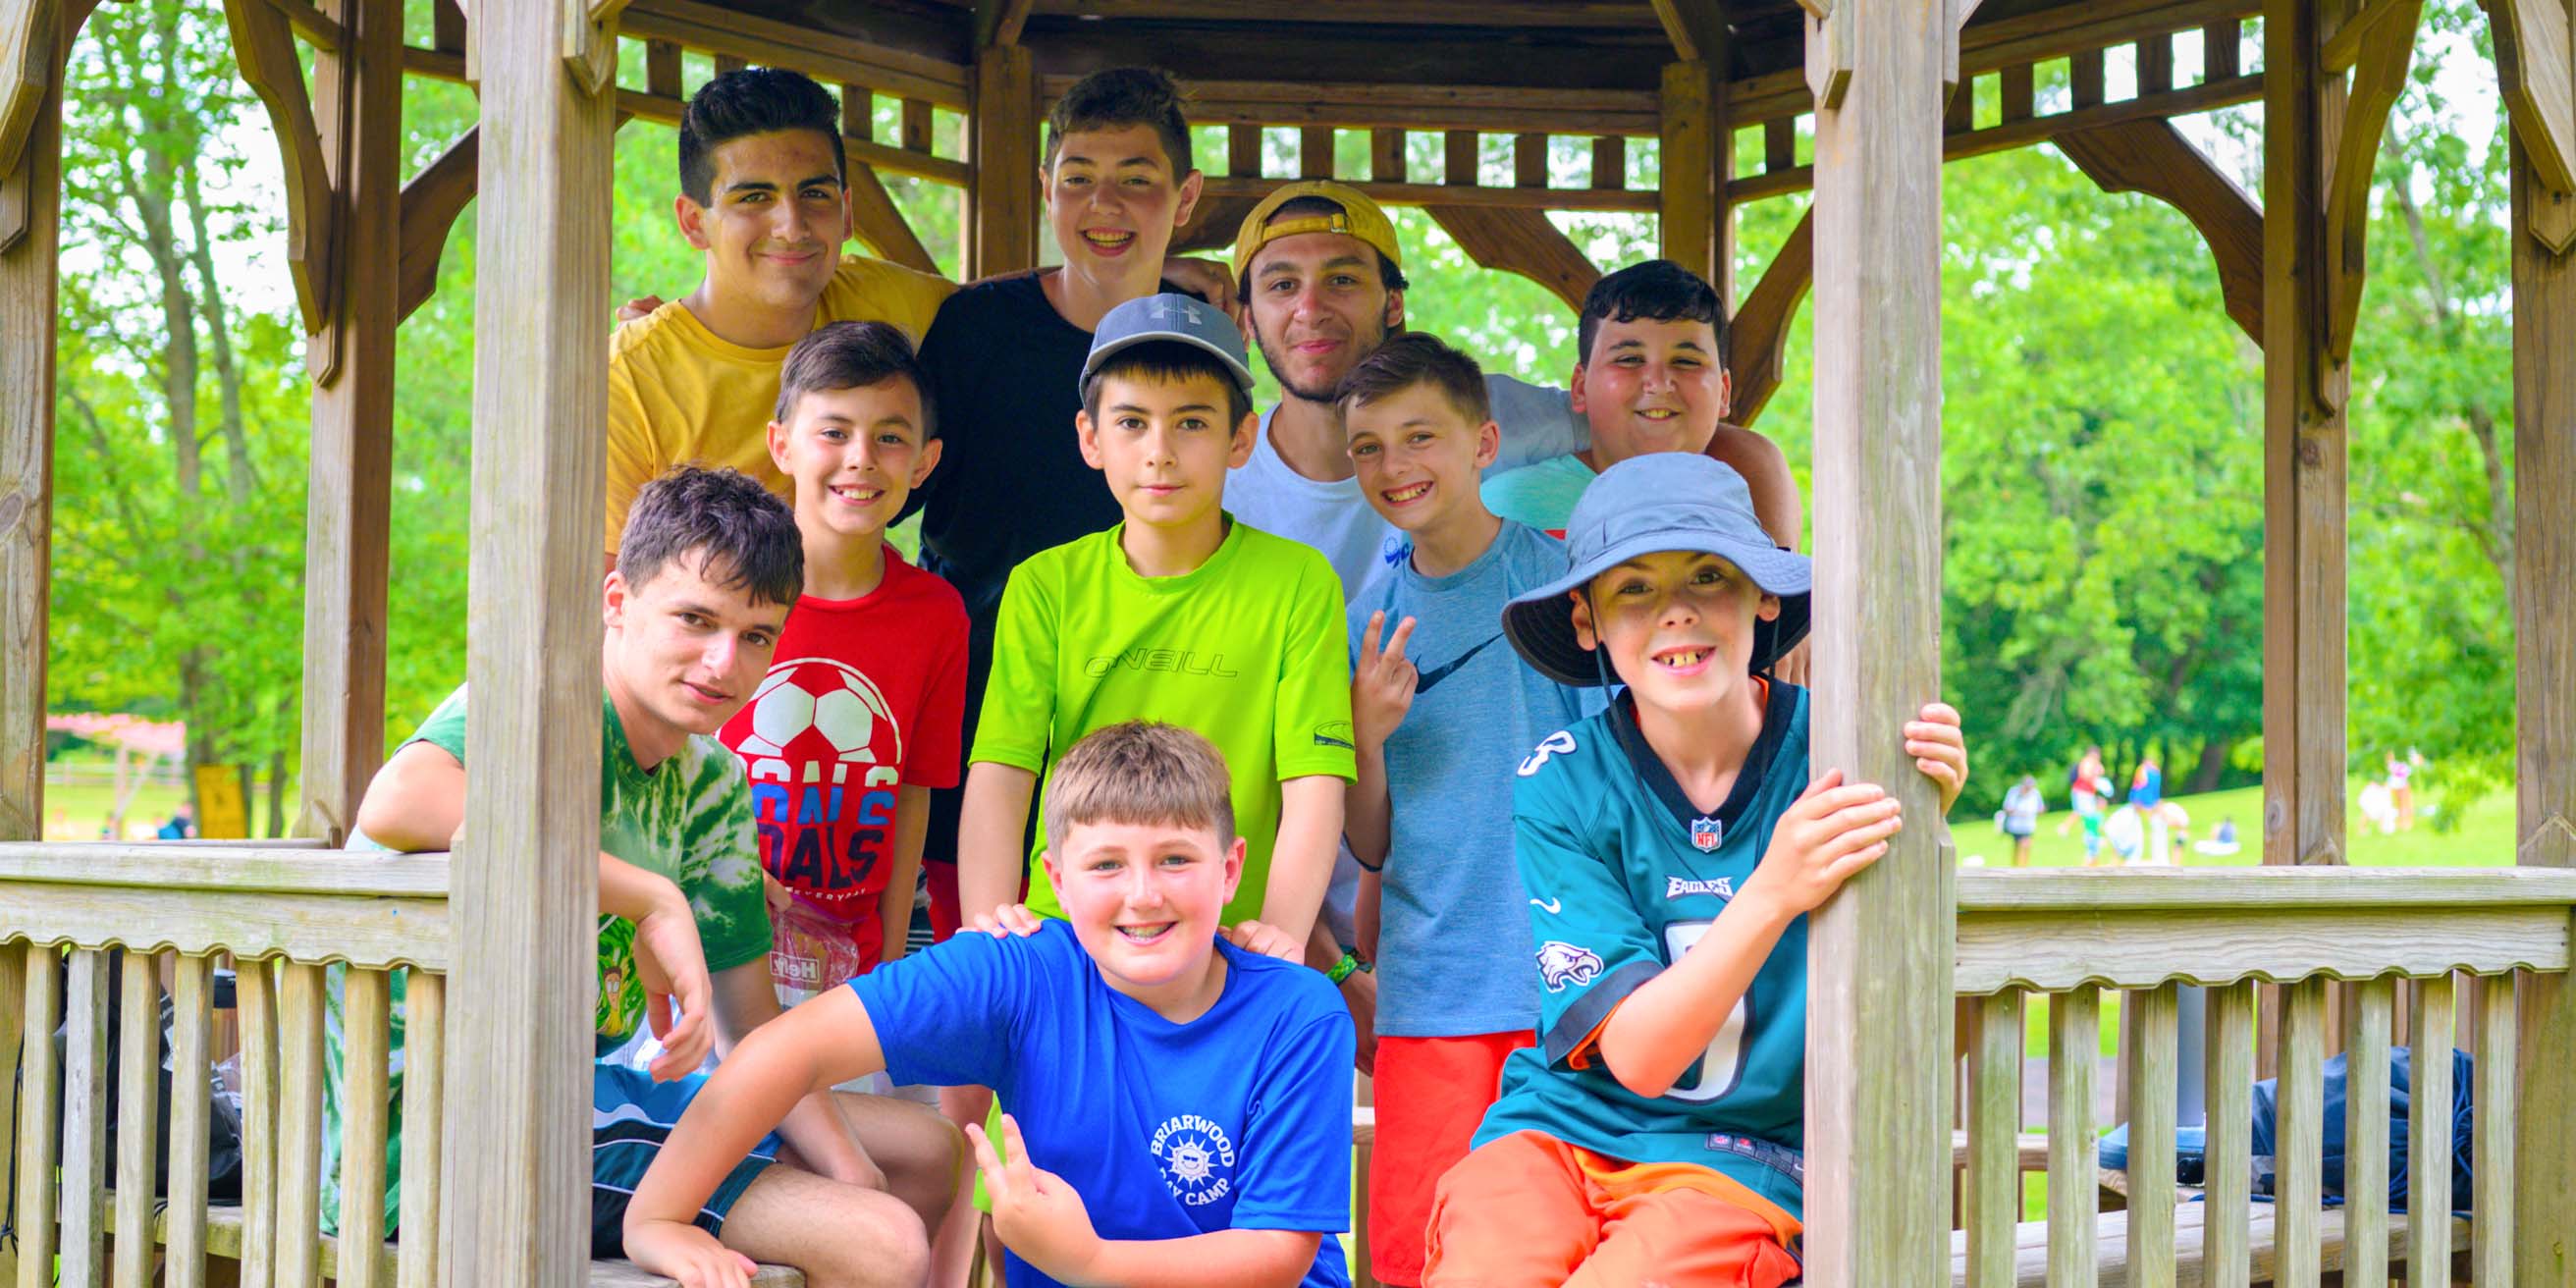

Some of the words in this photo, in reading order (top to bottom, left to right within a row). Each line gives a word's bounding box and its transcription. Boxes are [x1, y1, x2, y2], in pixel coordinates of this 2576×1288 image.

[1695, 832, 1719, 848] NFL
[1665, 875, 1735, 900] EAGLES
[1150, 1114, 1236, 1168] BRIARWOOD
[1184, 1177, 1231, 1207] CAMP
